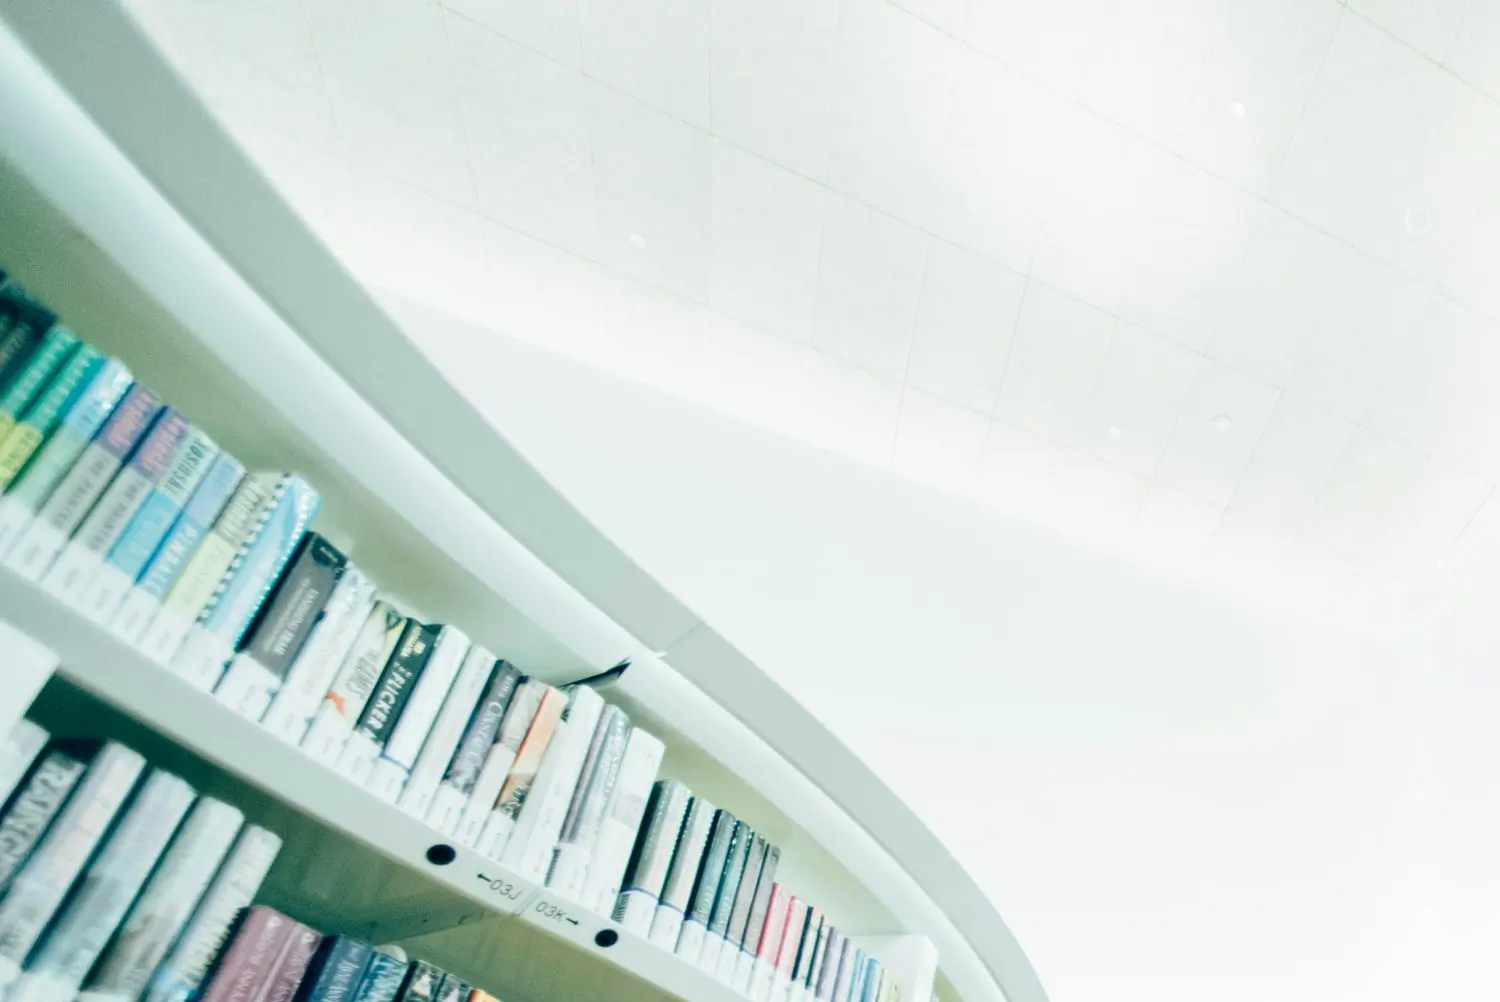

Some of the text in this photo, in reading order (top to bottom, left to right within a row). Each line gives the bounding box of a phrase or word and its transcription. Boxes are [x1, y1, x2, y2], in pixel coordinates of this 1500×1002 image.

[364, 670, 408, 732] FLICKER
[486, 878, 524, 901] 03J
[531, 900, 569, 923] 03K
